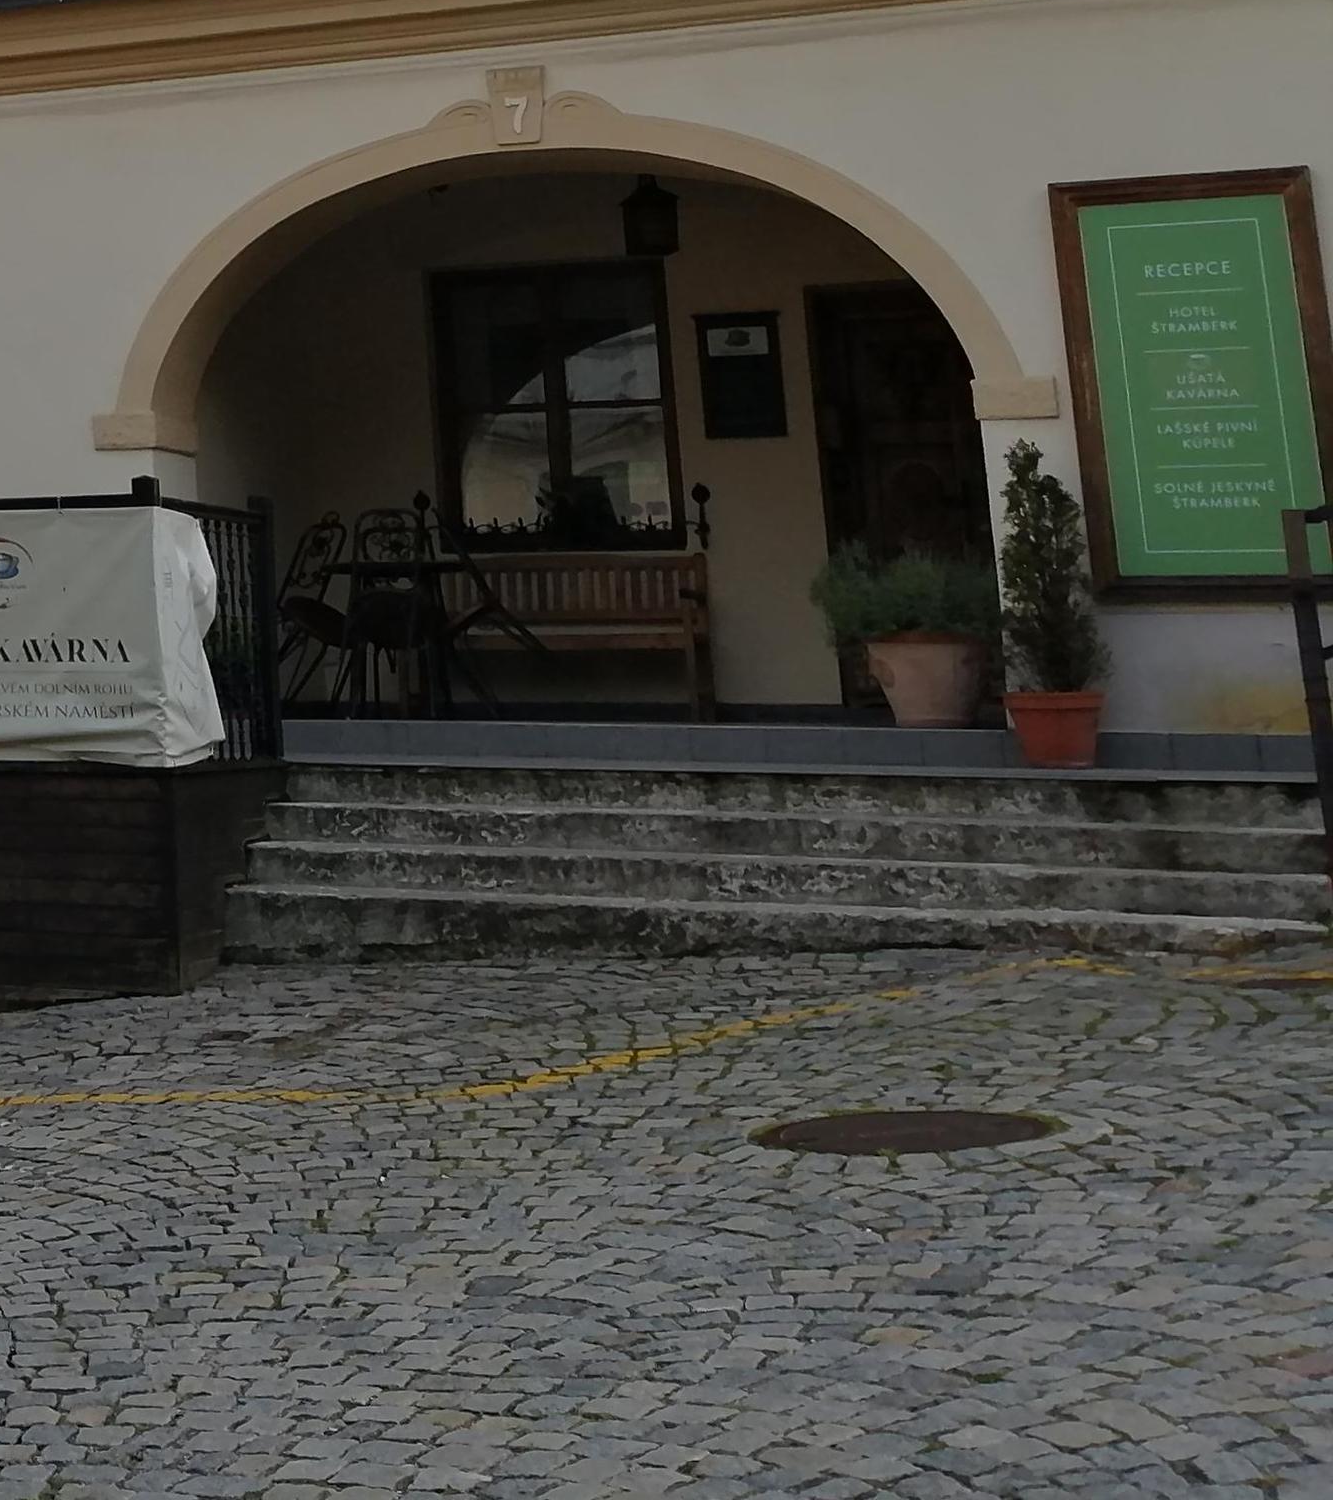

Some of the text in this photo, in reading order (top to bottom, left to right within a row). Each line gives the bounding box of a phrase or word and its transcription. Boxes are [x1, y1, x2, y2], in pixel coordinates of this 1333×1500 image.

[504, 96, 528, 135] 7
[1144, 260, 1232, 278] RECEPCE
[1169, 306, 1218, 318] HOTEL
[1150, 320, 1238, 335] ŠTRAMBERK
[94, 682, 134, 696] ROHU
